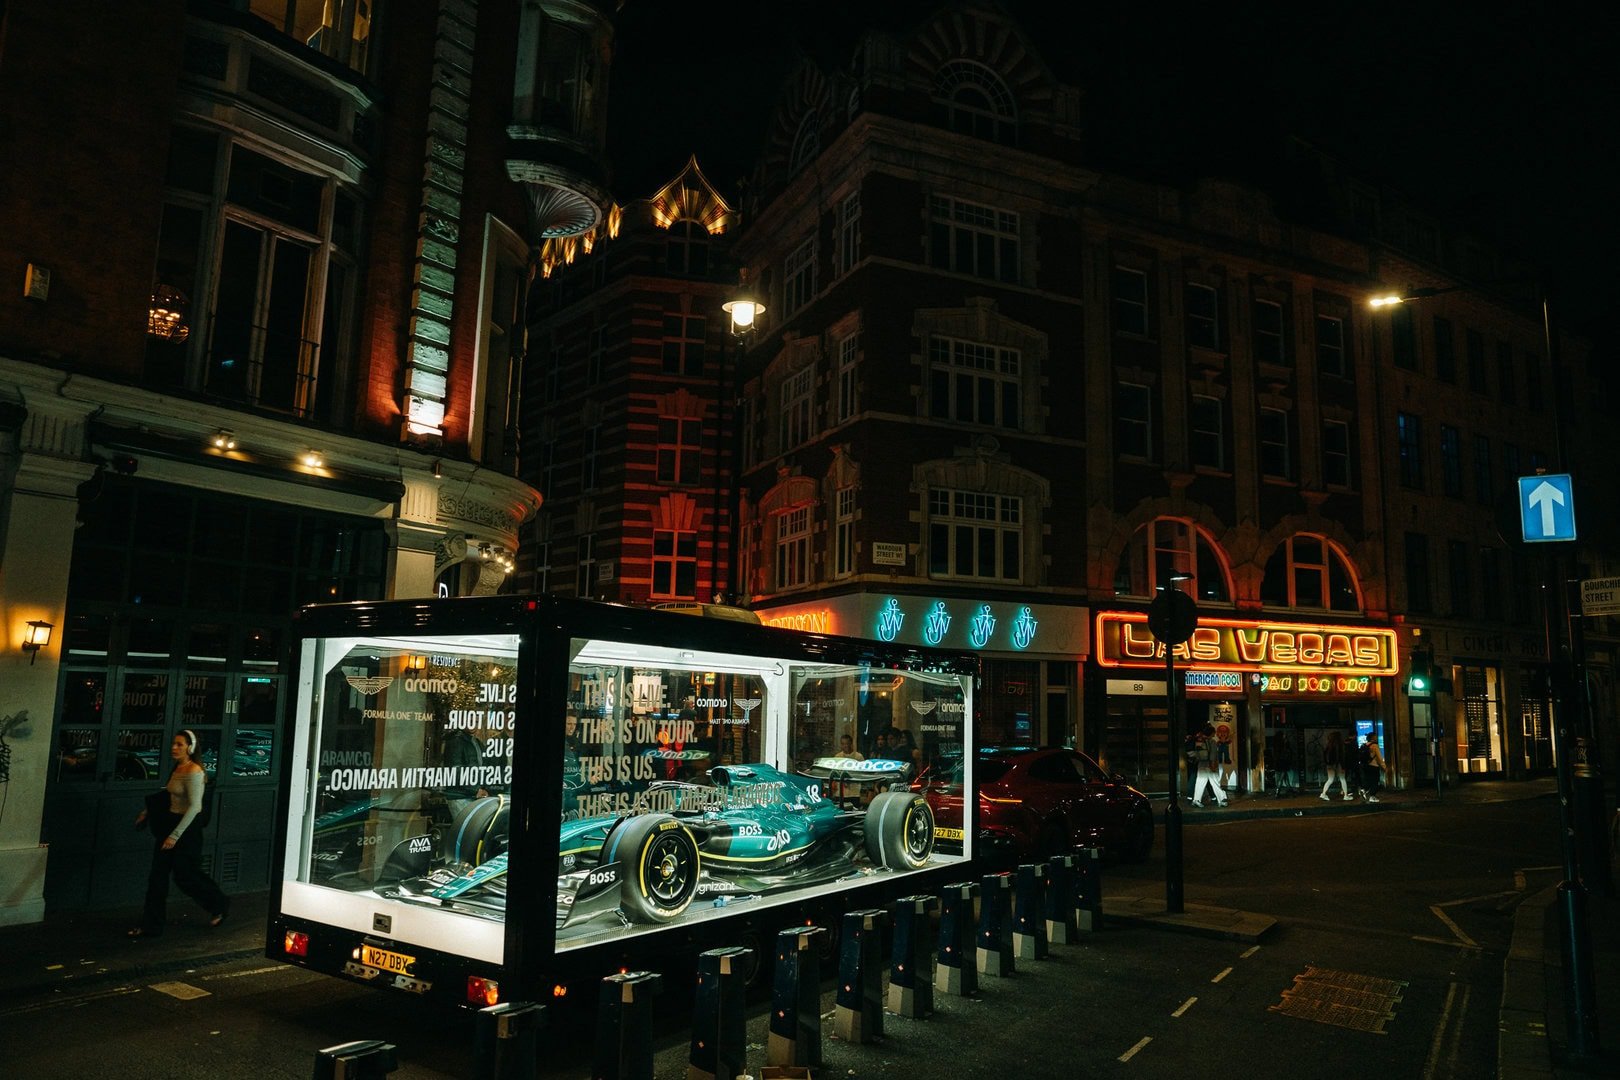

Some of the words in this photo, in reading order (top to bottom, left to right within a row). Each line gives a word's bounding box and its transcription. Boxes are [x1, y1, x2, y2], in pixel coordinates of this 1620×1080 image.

[1585, 591, 1614, 603] STREET
[1236, 628, 1381, 668] VEGAS
[404, 678, 458, 694] aramco
[1221, 673, 1241, 687] POOL
[1133, 683, 1144, 692] 89
[363, 709, 396, 720] FORMULA
[396, 710, 412, 720] ONE
[414, 712, 434, 722] TEAM
[580, 718, 616, 744] THIS
[618, 718, 633, 744] IS
[636, 718, 657, 744] ON
[659, 719, 698, 744] TOUR.
[578, 755, 613, 783] THIS
[616, 755, 631, 782] IS
[633, 754, 657, 781] US.
[823, 759, 896, 773] aramco
[806, 784, 821, 804] 18
[577, 794, 611, 820] THIS
[615, 791, 629, 817] IS
[632, 789, 677, 817] ASTON
[739, 825, 763, 836] BOSS
[409, 838, 431, 848] AVA
[409, 846, 431, 854] TRADE
[589, 870, 616, 886] BOSS
[696, 881, 735, 895] gnizant
[369, 949, 388, 967] N27
[389, 954, 409, 972] DBX
